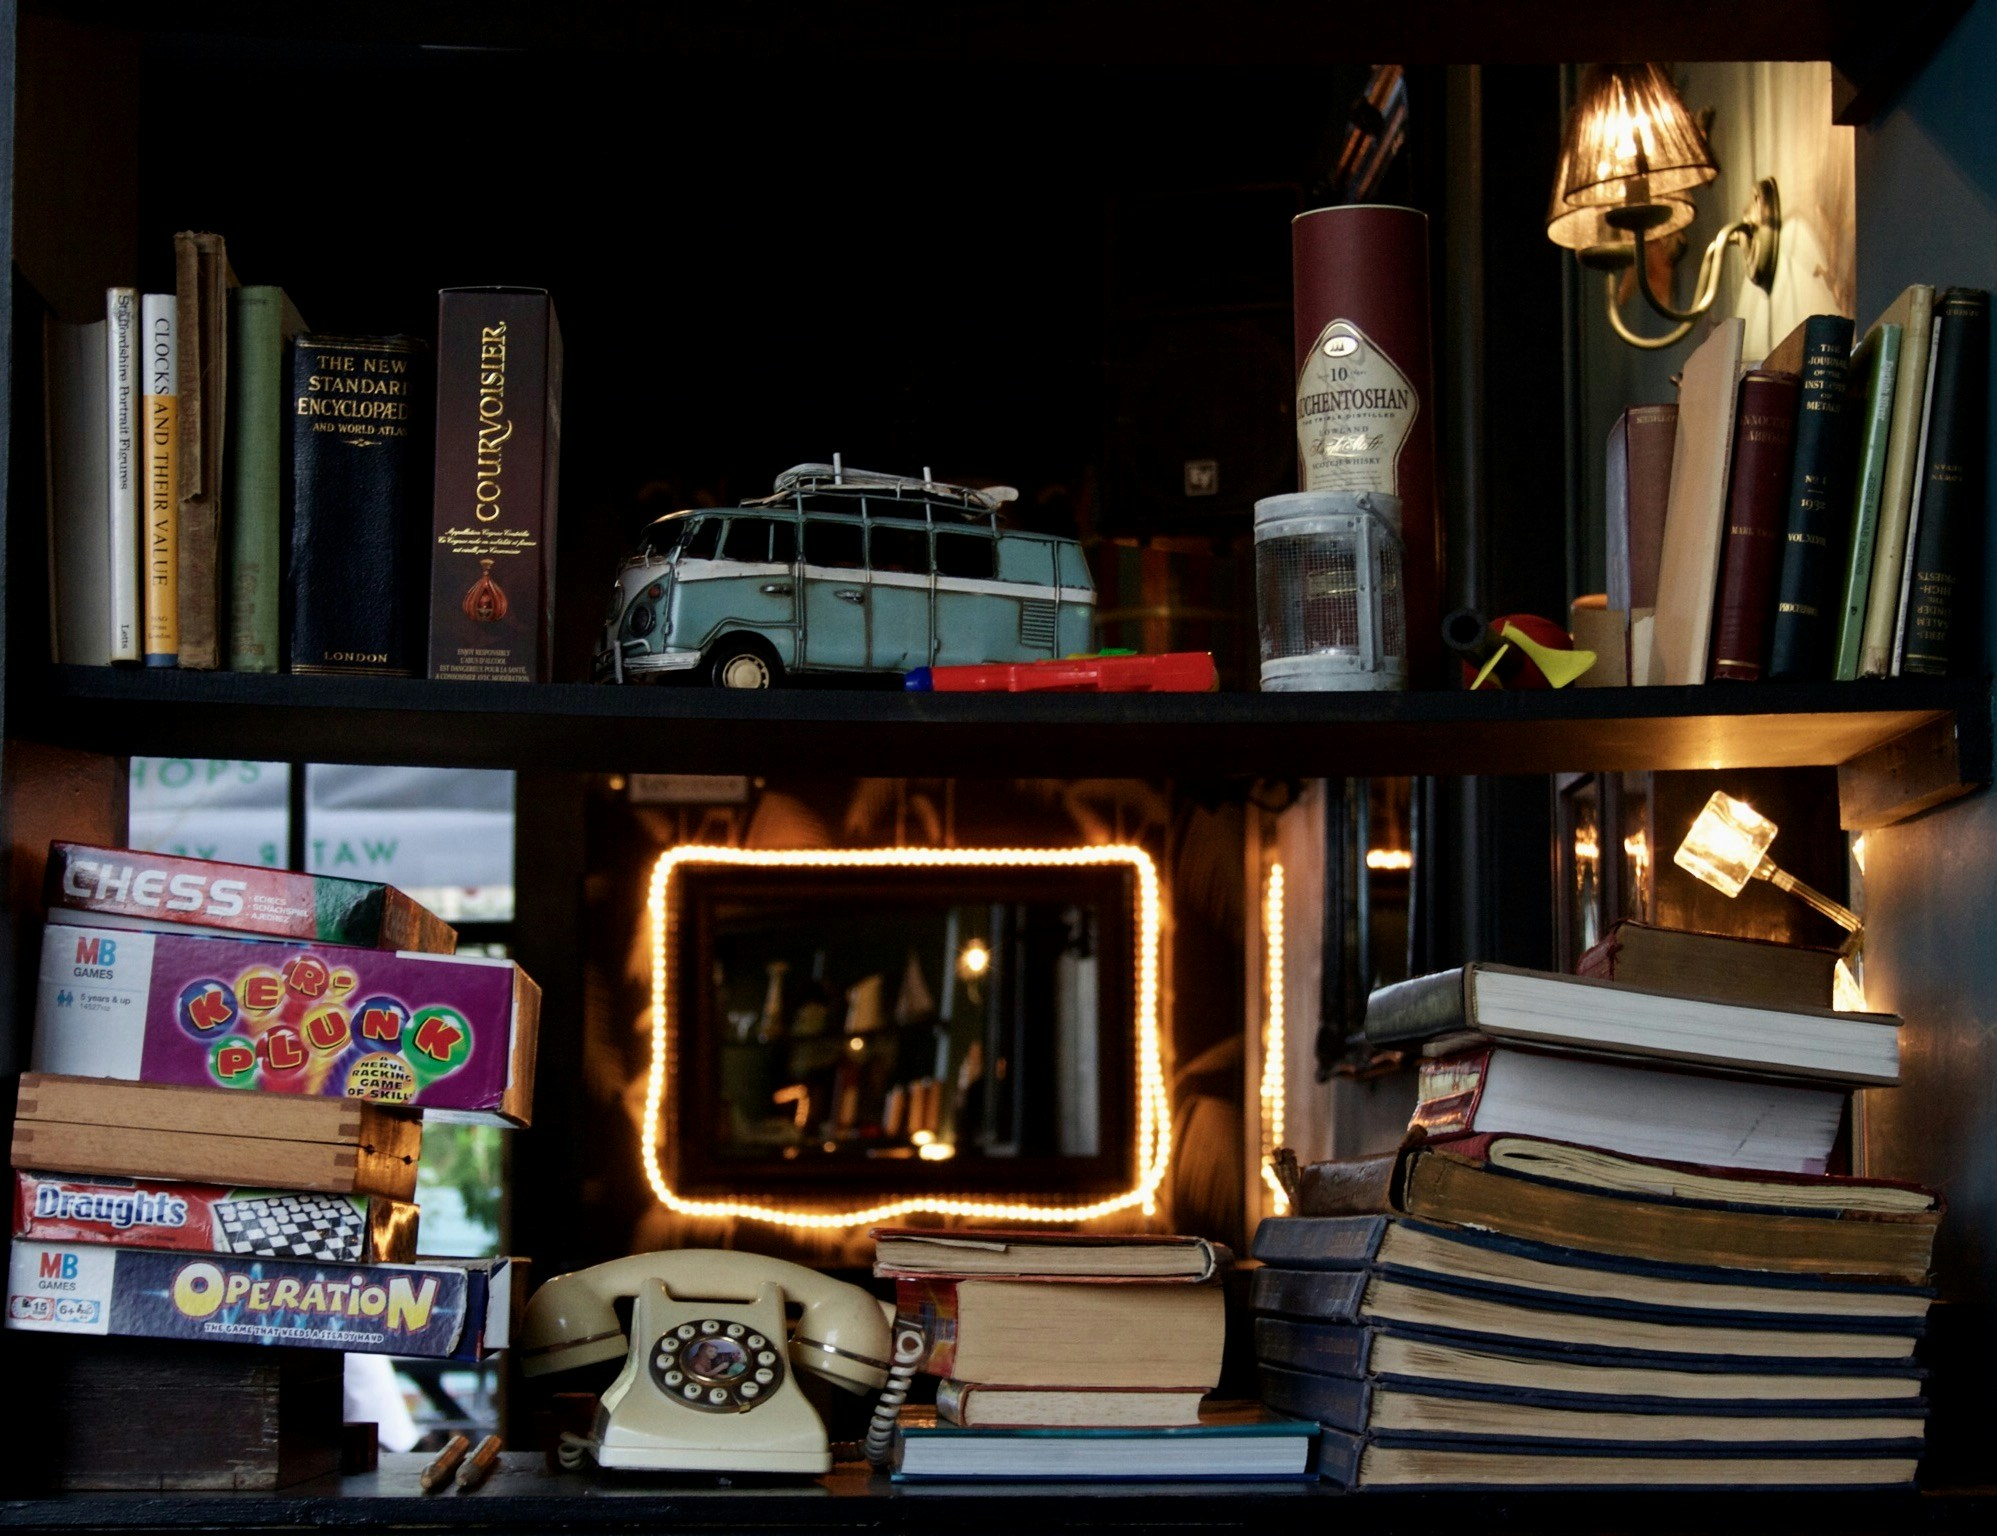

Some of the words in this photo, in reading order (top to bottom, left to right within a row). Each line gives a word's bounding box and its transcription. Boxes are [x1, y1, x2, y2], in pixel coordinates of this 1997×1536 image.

[116, 295, 131, 382] Staffordshire
[153, 317, 169, 396] CLOCKS
[317, 355, 355, 371] THE
[363, 359, 409, 374] NEW
[1331, 367, 1348, 382] 10
[116, 386, 130, 435] Portrait
[153, 401, 169, 446] AND
[476, 320, 513, 522] COURVOISIER
[312, 422, 336, 433] AND
[338, 423, 376, 435] WORLD
[378, 425, 409, 437] ATLAS
[116, 438, 130, 490] Figures
[1343, 457, 1381, 466] WHISKY
[153, 451, 169, 512] THEIR
[151, 519, 168, 587] VALUE
[119, 623, 130, 650] Letts
[323, 650, 389, 663] LONDON
[63, 858, 247, 918] CHESS
[76, 936, 116, 966] MB
[73, 967, 114, 979] GAMES
[88, 995, 110, 1004] years
[120, 997, 131, 1006] up
[188, 961, 351, 1030] KER-
[217, 1009, 463, 1078] PLUNK
[352, 1069, 412, 1082] RACKING
[361, 1062, 405, 1072] NERVE
[348, 1087, 365, 1096] OF
[360, 1078, 403, 1090] GAME
[36, 1185, 187, 1227] Draughts
[39, 1251, 79, 1279] MB
[38, 1280, 76, 1291] GAMES
[34, 1302, 47, 1311] 15
[204, 1322, 224, 1332] THE
[226, 1323, 253, 1334] GAME
[254, 1325, 280, 1336] THAT
[281, 1328, 311, 1339] NEEDS
[321, 1330, 357, 1342] STEADY
[357, 1332, 385, 1343] HAND
